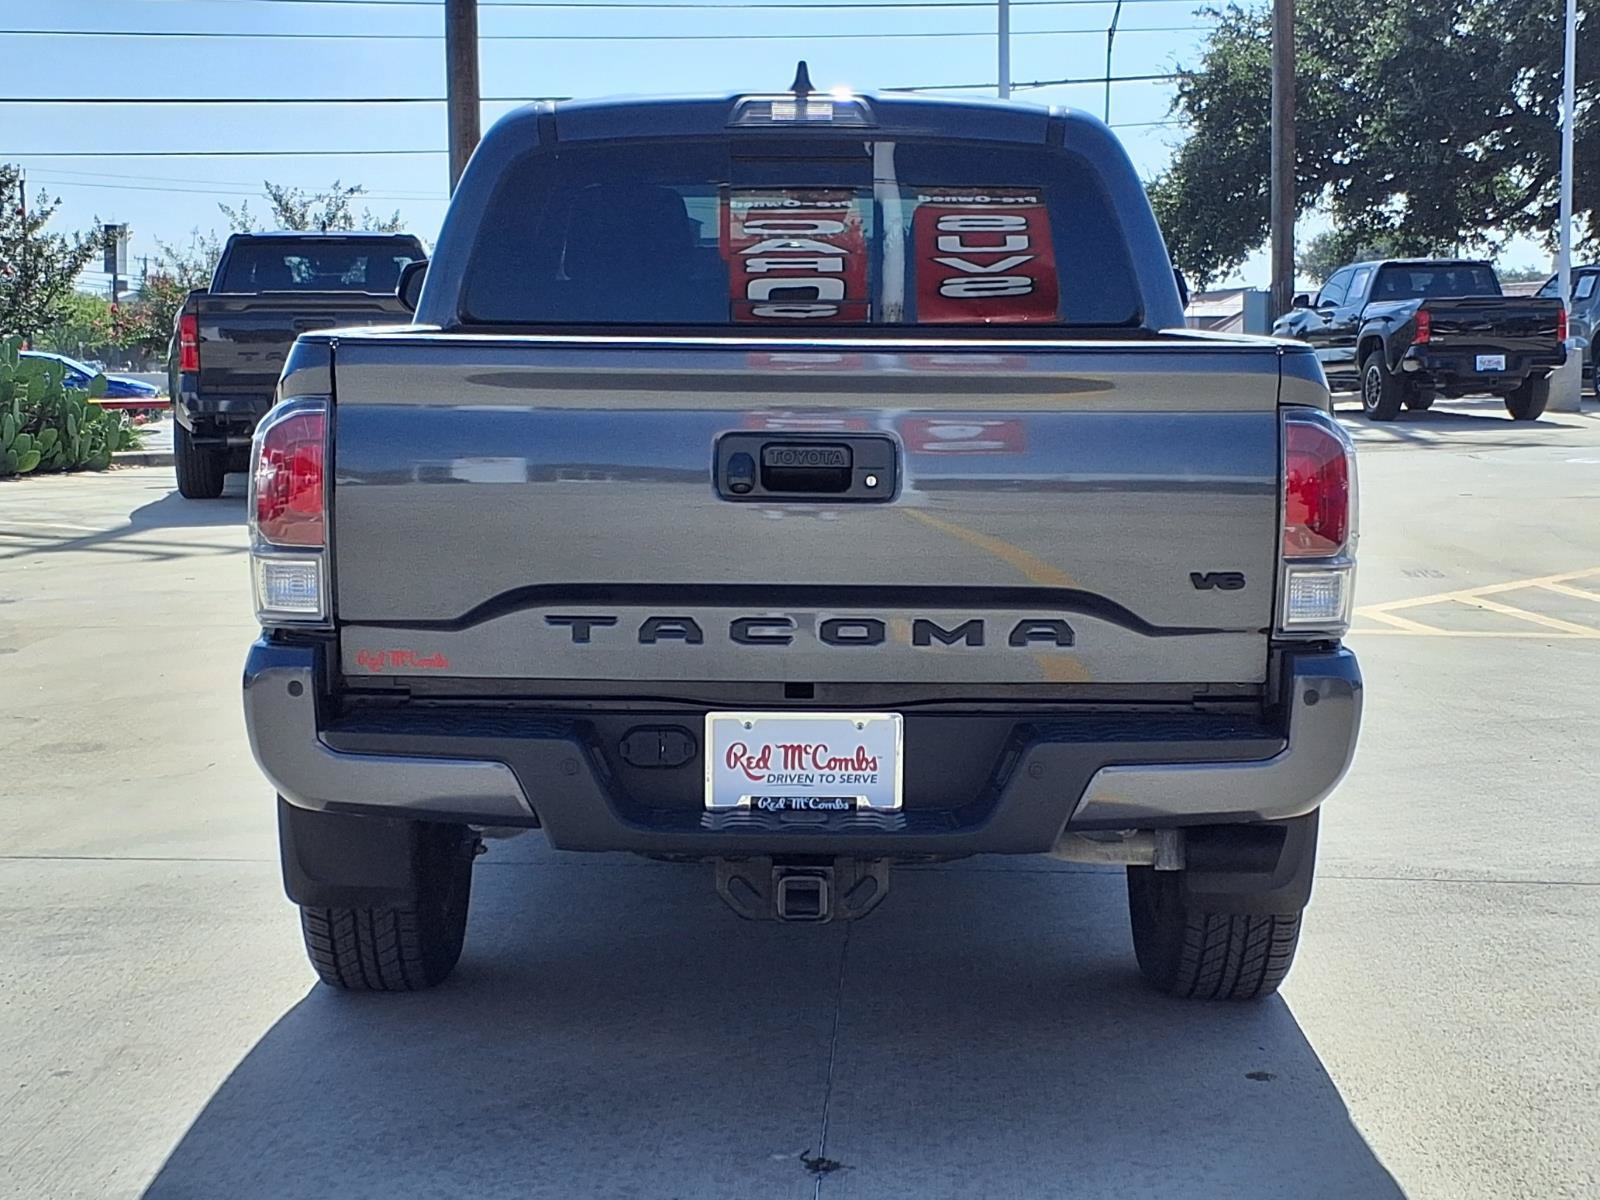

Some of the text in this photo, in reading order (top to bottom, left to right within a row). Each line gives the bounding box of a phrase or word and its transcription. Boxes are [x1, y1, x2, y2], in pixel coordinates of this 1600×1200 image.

[771, 450, 845, 465] TOYOTA
[1189, 572, 1246, 590] V6
[544, 614, 1076, 648] TACOMA
[726, 742, 878, 781] Red McCombs
[766, 773, 878, 784] DRIVEN TO SERVE
[757, 797, 849, 812] Red McCombs
